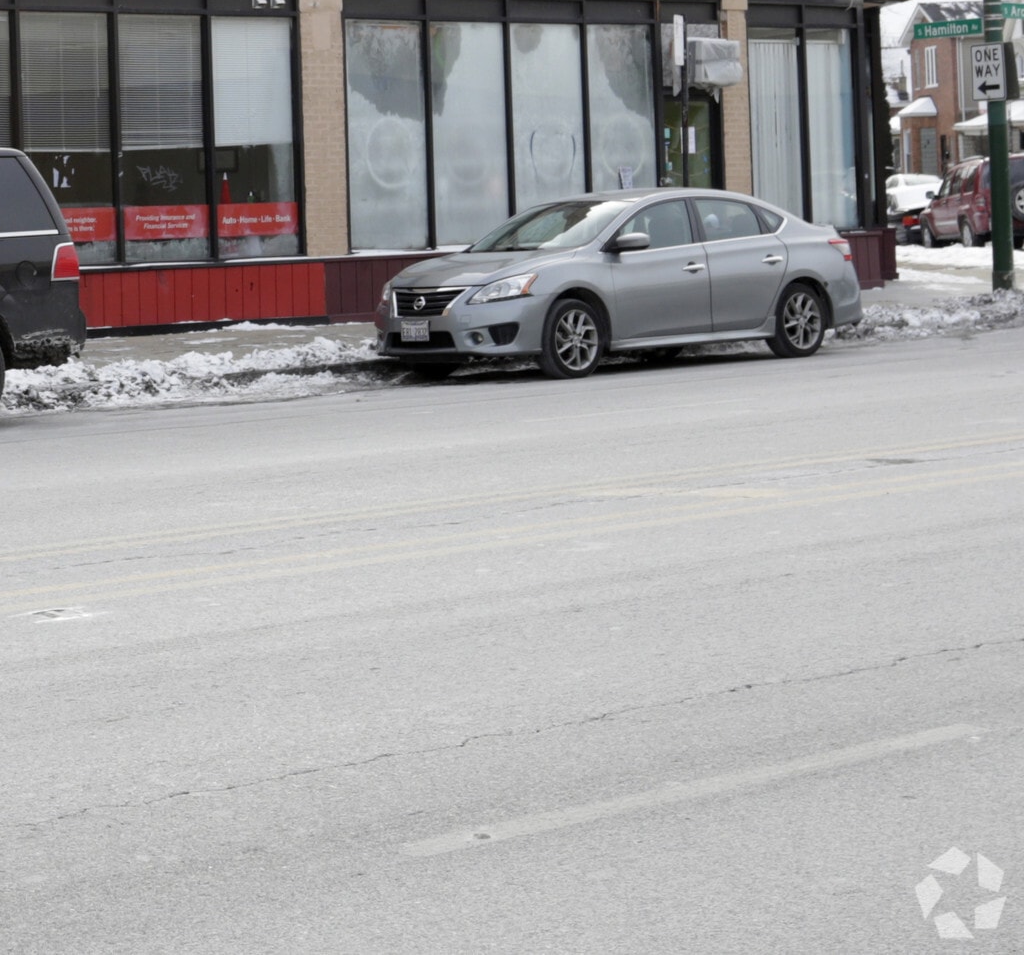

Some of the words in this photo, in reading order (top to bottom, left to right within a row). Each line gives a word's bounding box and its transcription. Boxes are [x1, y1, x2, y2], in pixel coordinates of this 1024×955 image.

[924, 23, 969, 37] Hamilton
[975, 48, 999, 62] ONE
[975, 64, 1000, 78] WAY
[222, 216, 236, 225] Auto
[239, 215, 257, 224] Home
[260, 215, 272, 223] Life
[275, 214, 291, 223] Bank
